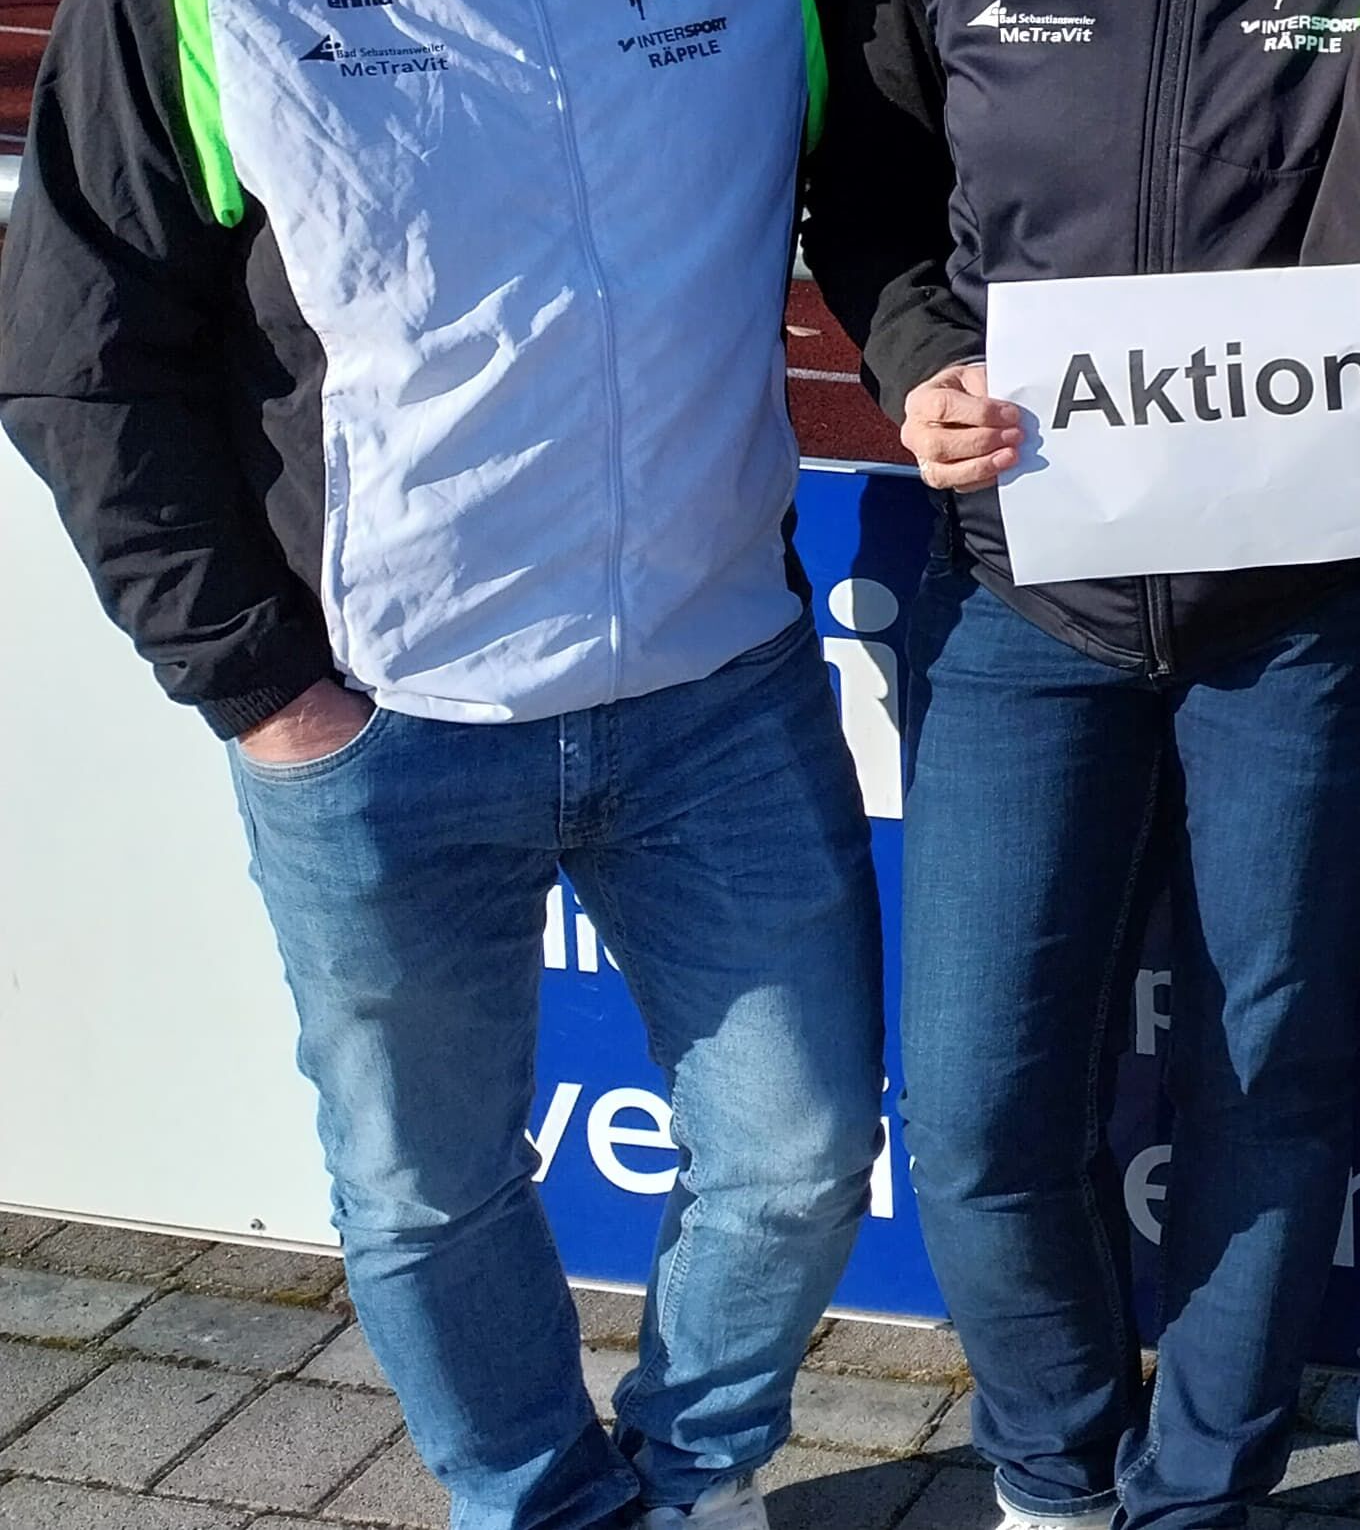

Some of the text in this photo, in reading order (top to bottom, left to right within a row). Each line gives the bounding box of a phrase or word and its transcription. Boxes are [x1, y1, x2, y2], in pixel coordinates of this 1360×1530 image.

[637, 16, 728, 49] INTERSPORT
[1000, 27, 1093, 43] MeTraVit
[1264, 31, 1342, 53] RÄPPLE
[648, 39, 721, 68] RÄPPLE
[340, 57, 449, 77] MeTraVit
